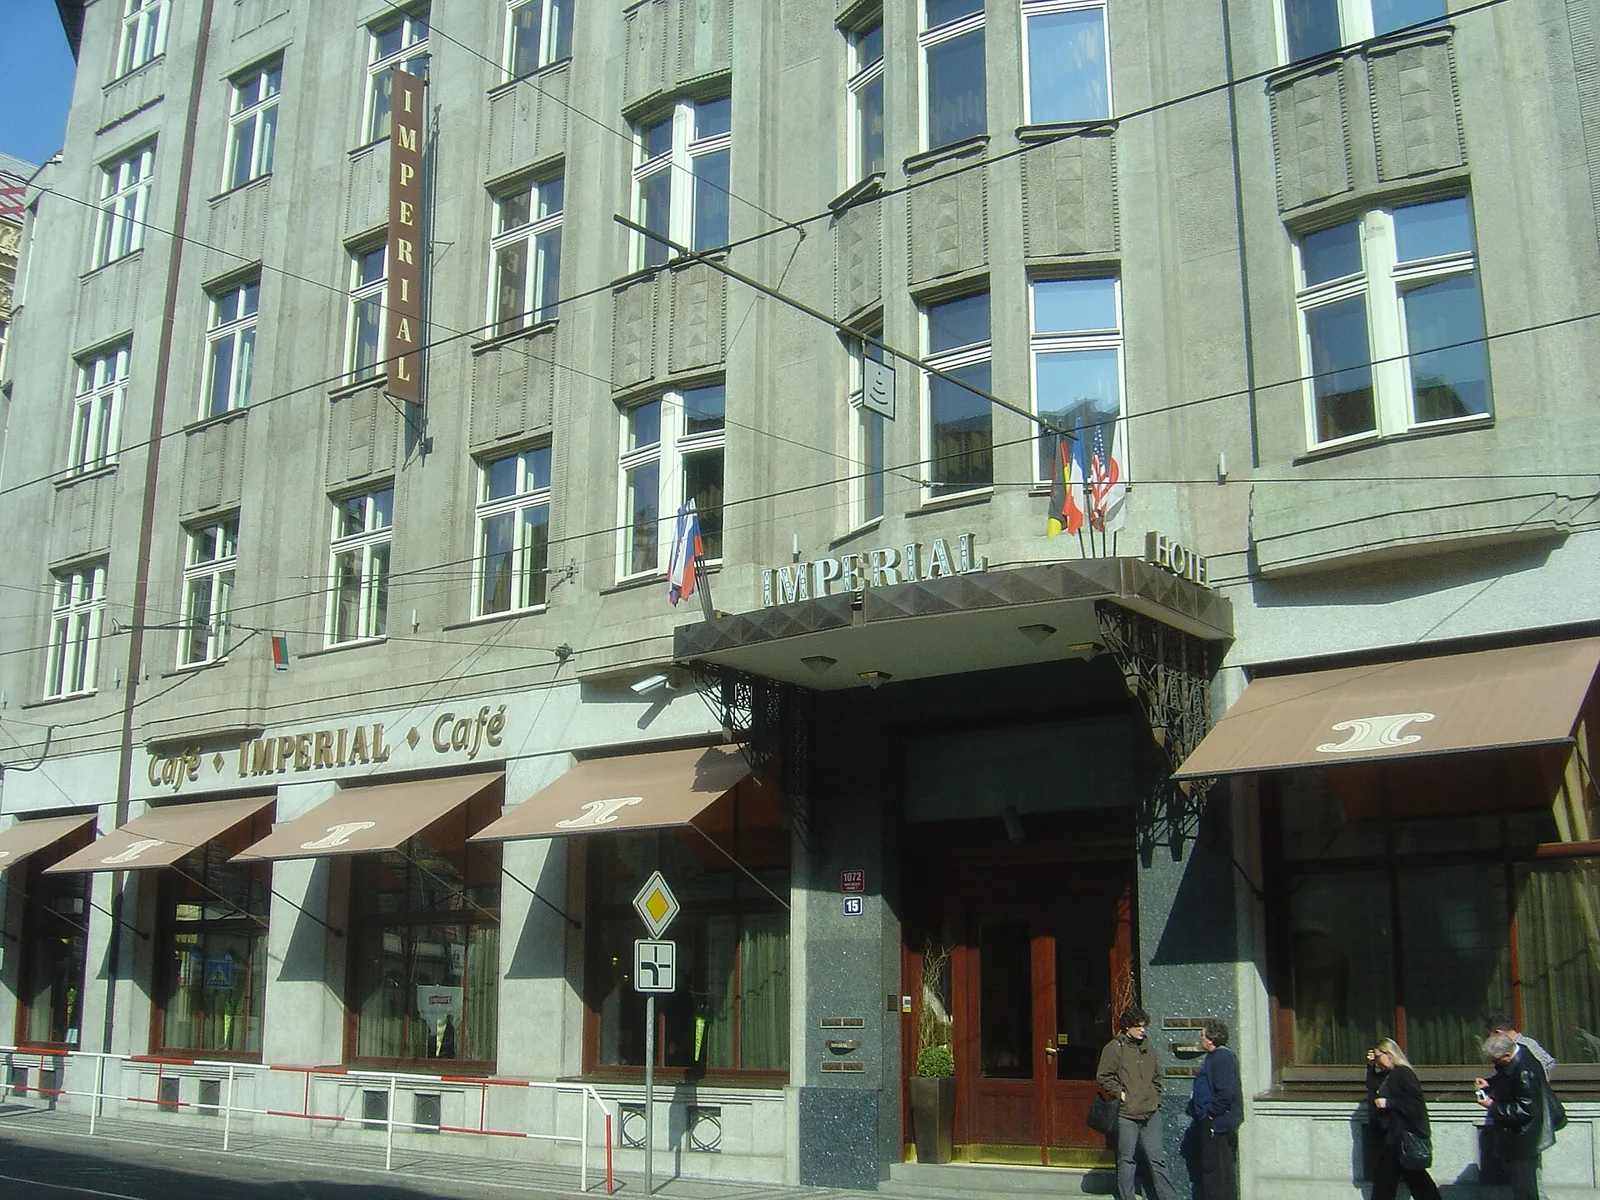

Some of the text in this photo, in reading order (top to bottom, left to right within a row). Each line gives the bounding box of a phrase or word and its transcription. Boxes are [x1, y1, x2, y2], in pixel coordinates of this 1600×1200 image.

[396, 89, 417, 382] IMPERIAL
[761, 532, 989, 608] IMPERIAL
[148, 704, 507, 792] Café IMPERIAL Café
[843, 872, 862, 882] 1072
[846, 900, 859, 912] 15
